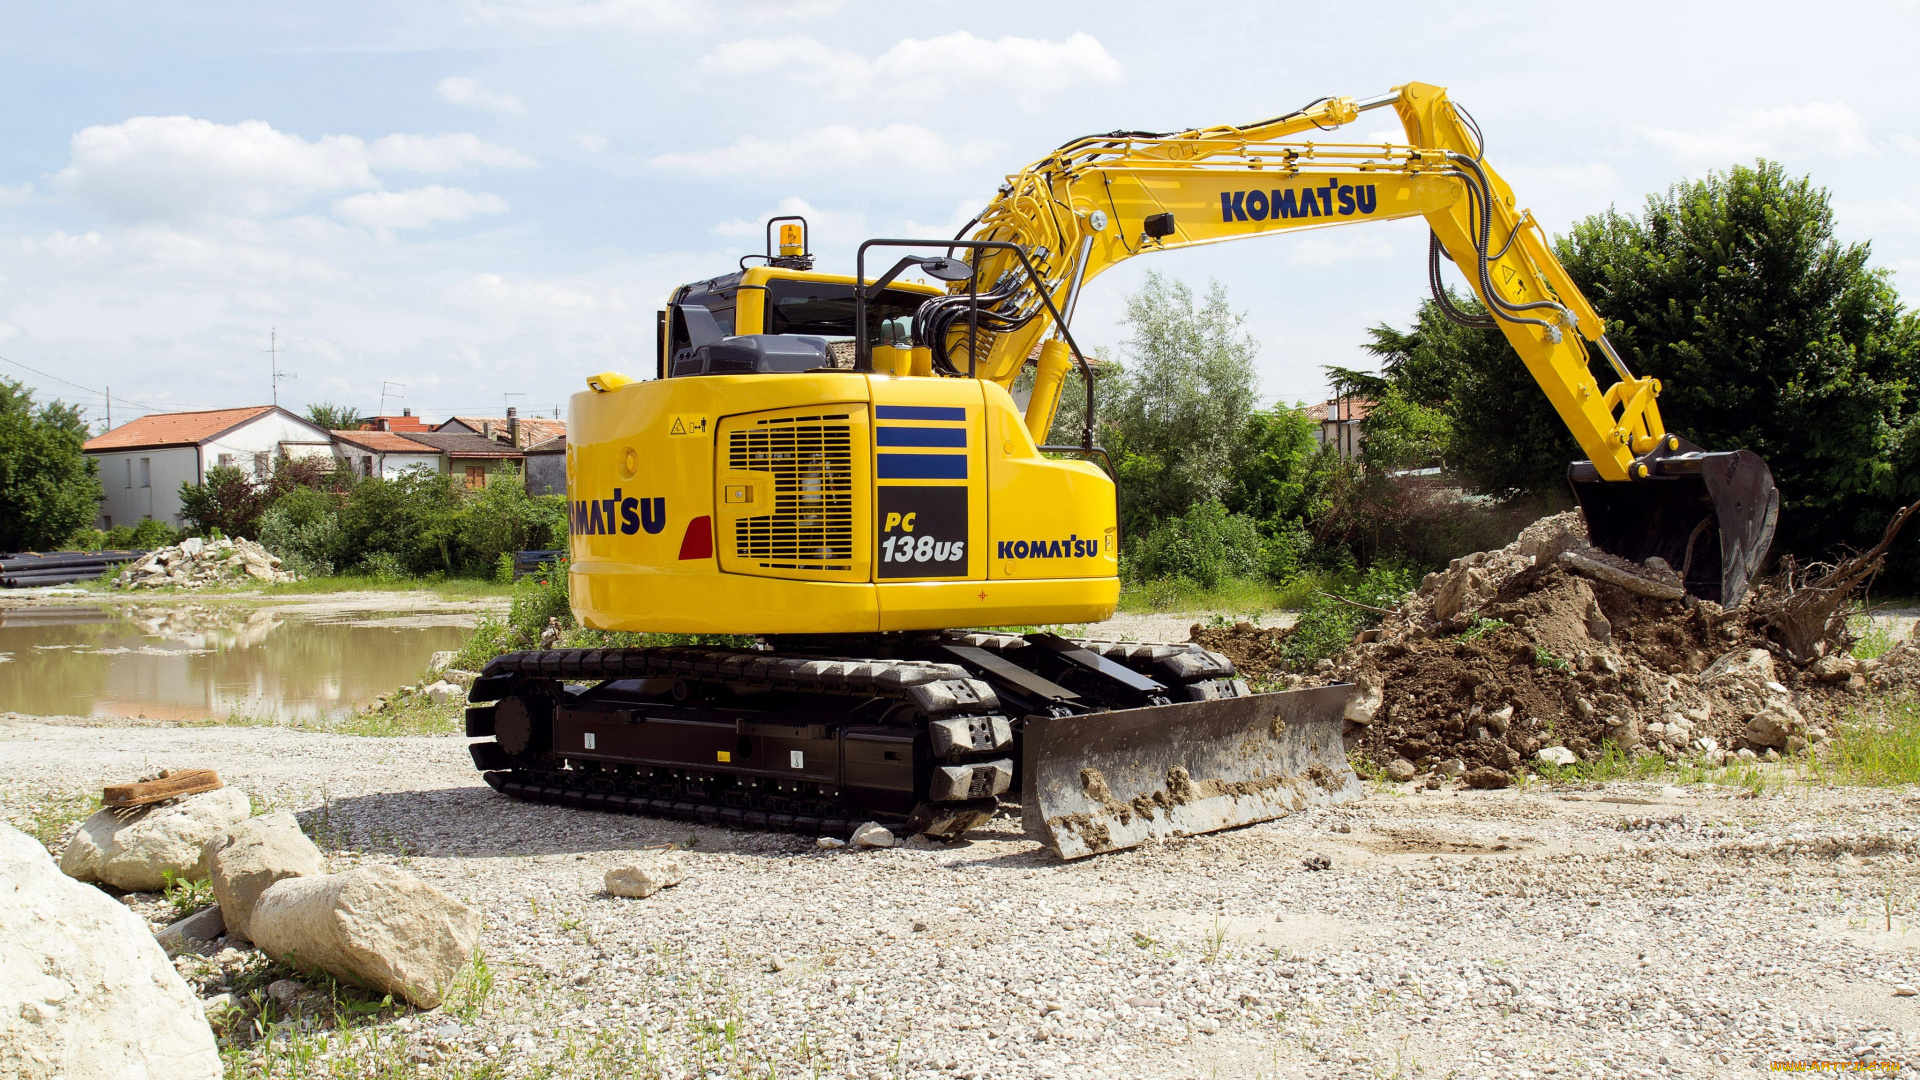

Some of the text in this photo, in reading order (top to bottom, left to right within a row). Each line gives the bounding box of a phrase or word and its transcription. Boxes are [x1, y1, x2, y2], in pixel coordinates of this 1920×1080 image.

[1220, 177, 1377, 222] KOMATSU
[567, 488, 666, 536] OMATSU
[884, 512, 917, 532] PC
[997, 534, 1098, 559] KOMATSU
